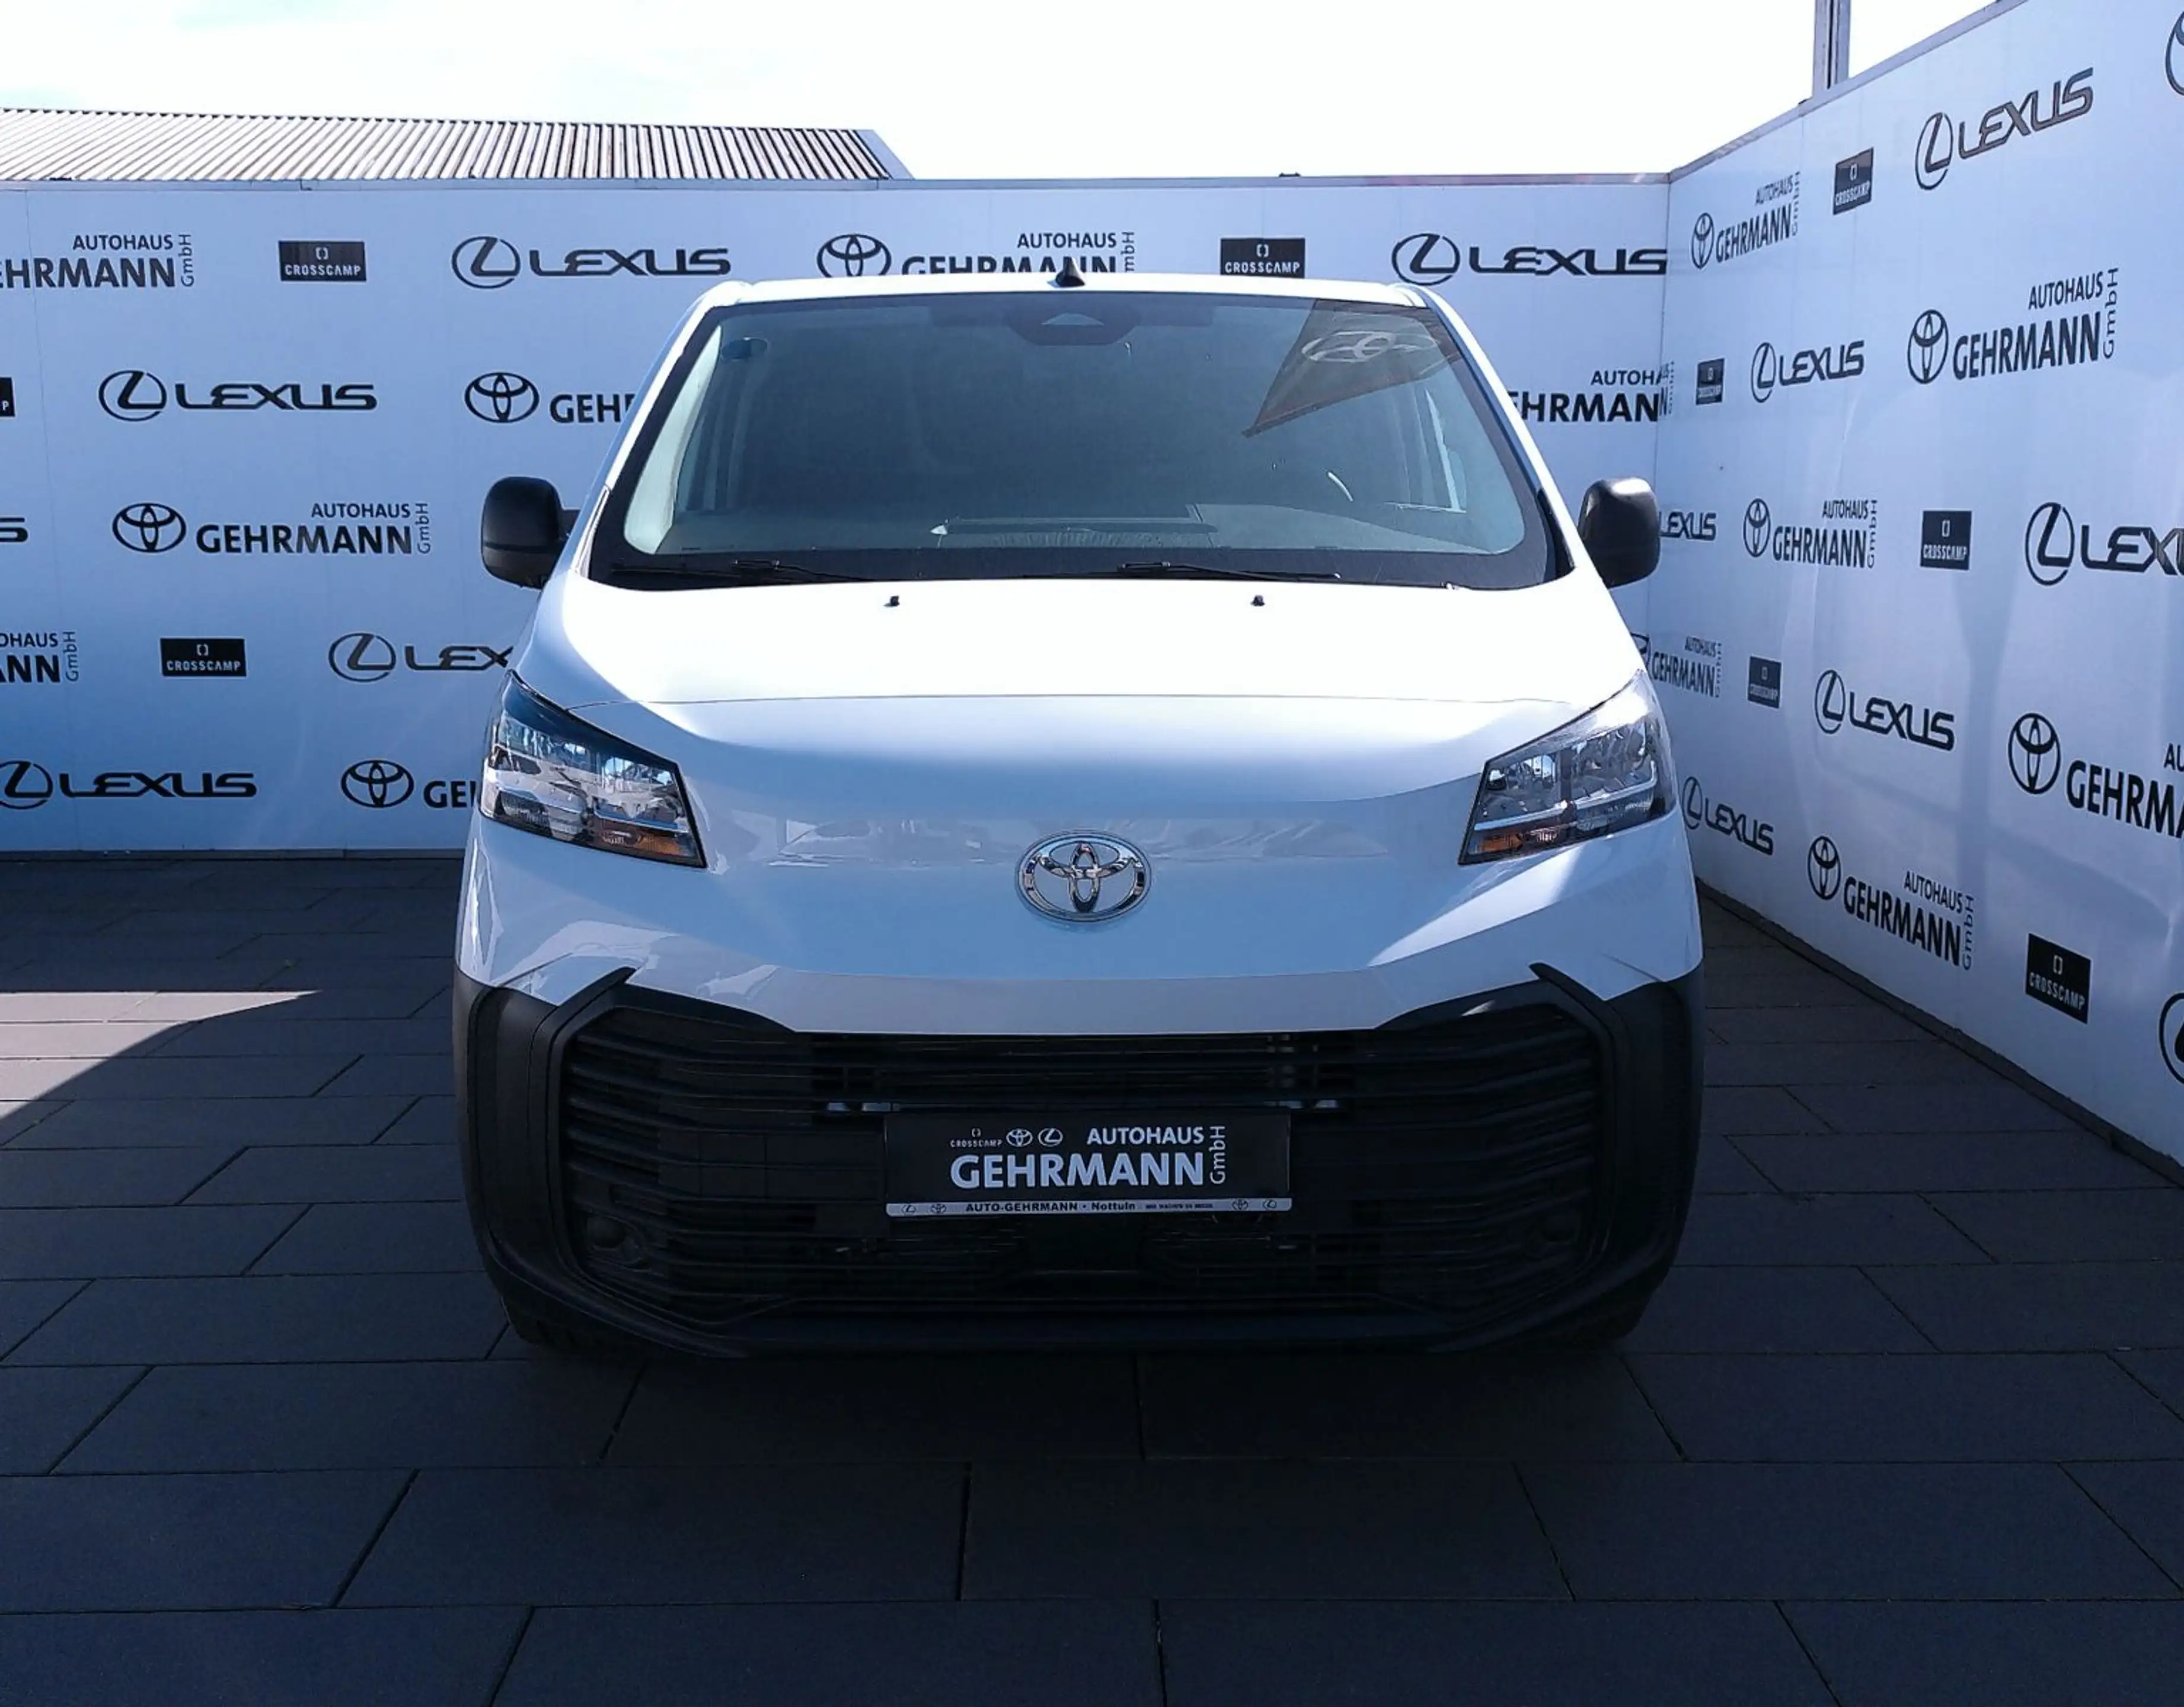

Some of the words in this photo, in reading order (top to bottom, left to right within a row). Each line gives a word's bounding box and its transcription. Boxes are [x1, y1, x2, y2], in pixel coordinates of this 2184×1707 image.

[1959, 68, 2093, 159] LEXUS
[73, 235, 173, 250] AUTOHAUS
[1017, 233, 1116, 248] AUTOHAUS
[1716, 205, 1791, 263] GEHRMANN
[0, 258, 175, 288] HRMANN
[178, 235, 194, 287] GmbH
[285, 264, 361, 276] CROSSCAMP
[529, 248, 730, 276] LEXUS
[1225, 261, 1300, 274] CROSSCAMP
[1470, 247, 1668, 276] LEXUS
[2029, 271, 2103, 310] AUTOHAUS
[2103, 268, 2118, 359] GmbH
[1779, 340, 1864, 386] LEXUS
[1953, 312, 2101, 381] GEHRMANN
[175, 383, 377, 410] LEXUS
[312, 503, 410, 518] AUTOHAUS
[416, 503, 430, 554] GmbH
[1822, 500, 1868, 520] AUTOHAUS
[196, 525, 411, 554] GEHRMANN
[1773, 525, 1866, 568] GEHRMANN
[2081, 525, 2184, 576] LEX
[62, 631, 79, 682] GmbH
[167, 660, 241, 671] CROSSCAMP
[1652, 652, 1714, 698] GEHRMANN
[1849, 692, 1955, 751] LEXUS
[59, 773, 257, 798] LEXUS
[1705, 798, 1774, 855] LEXUS
[1904, 872, 1963, 913] AUTOHAUS
[1844, 877, 1961, 966] GEHRMANN
[1962, 895, 1975, 971] GmbH
[2029, 971, 2086, 1012] CROSSCAMP
[1087, 1127, 1203, 1145] AUTOHAUS
[1209, 1126, 1226, 1184] GmbH
[951, 1152, 1203, 1188] GEHRMANN
